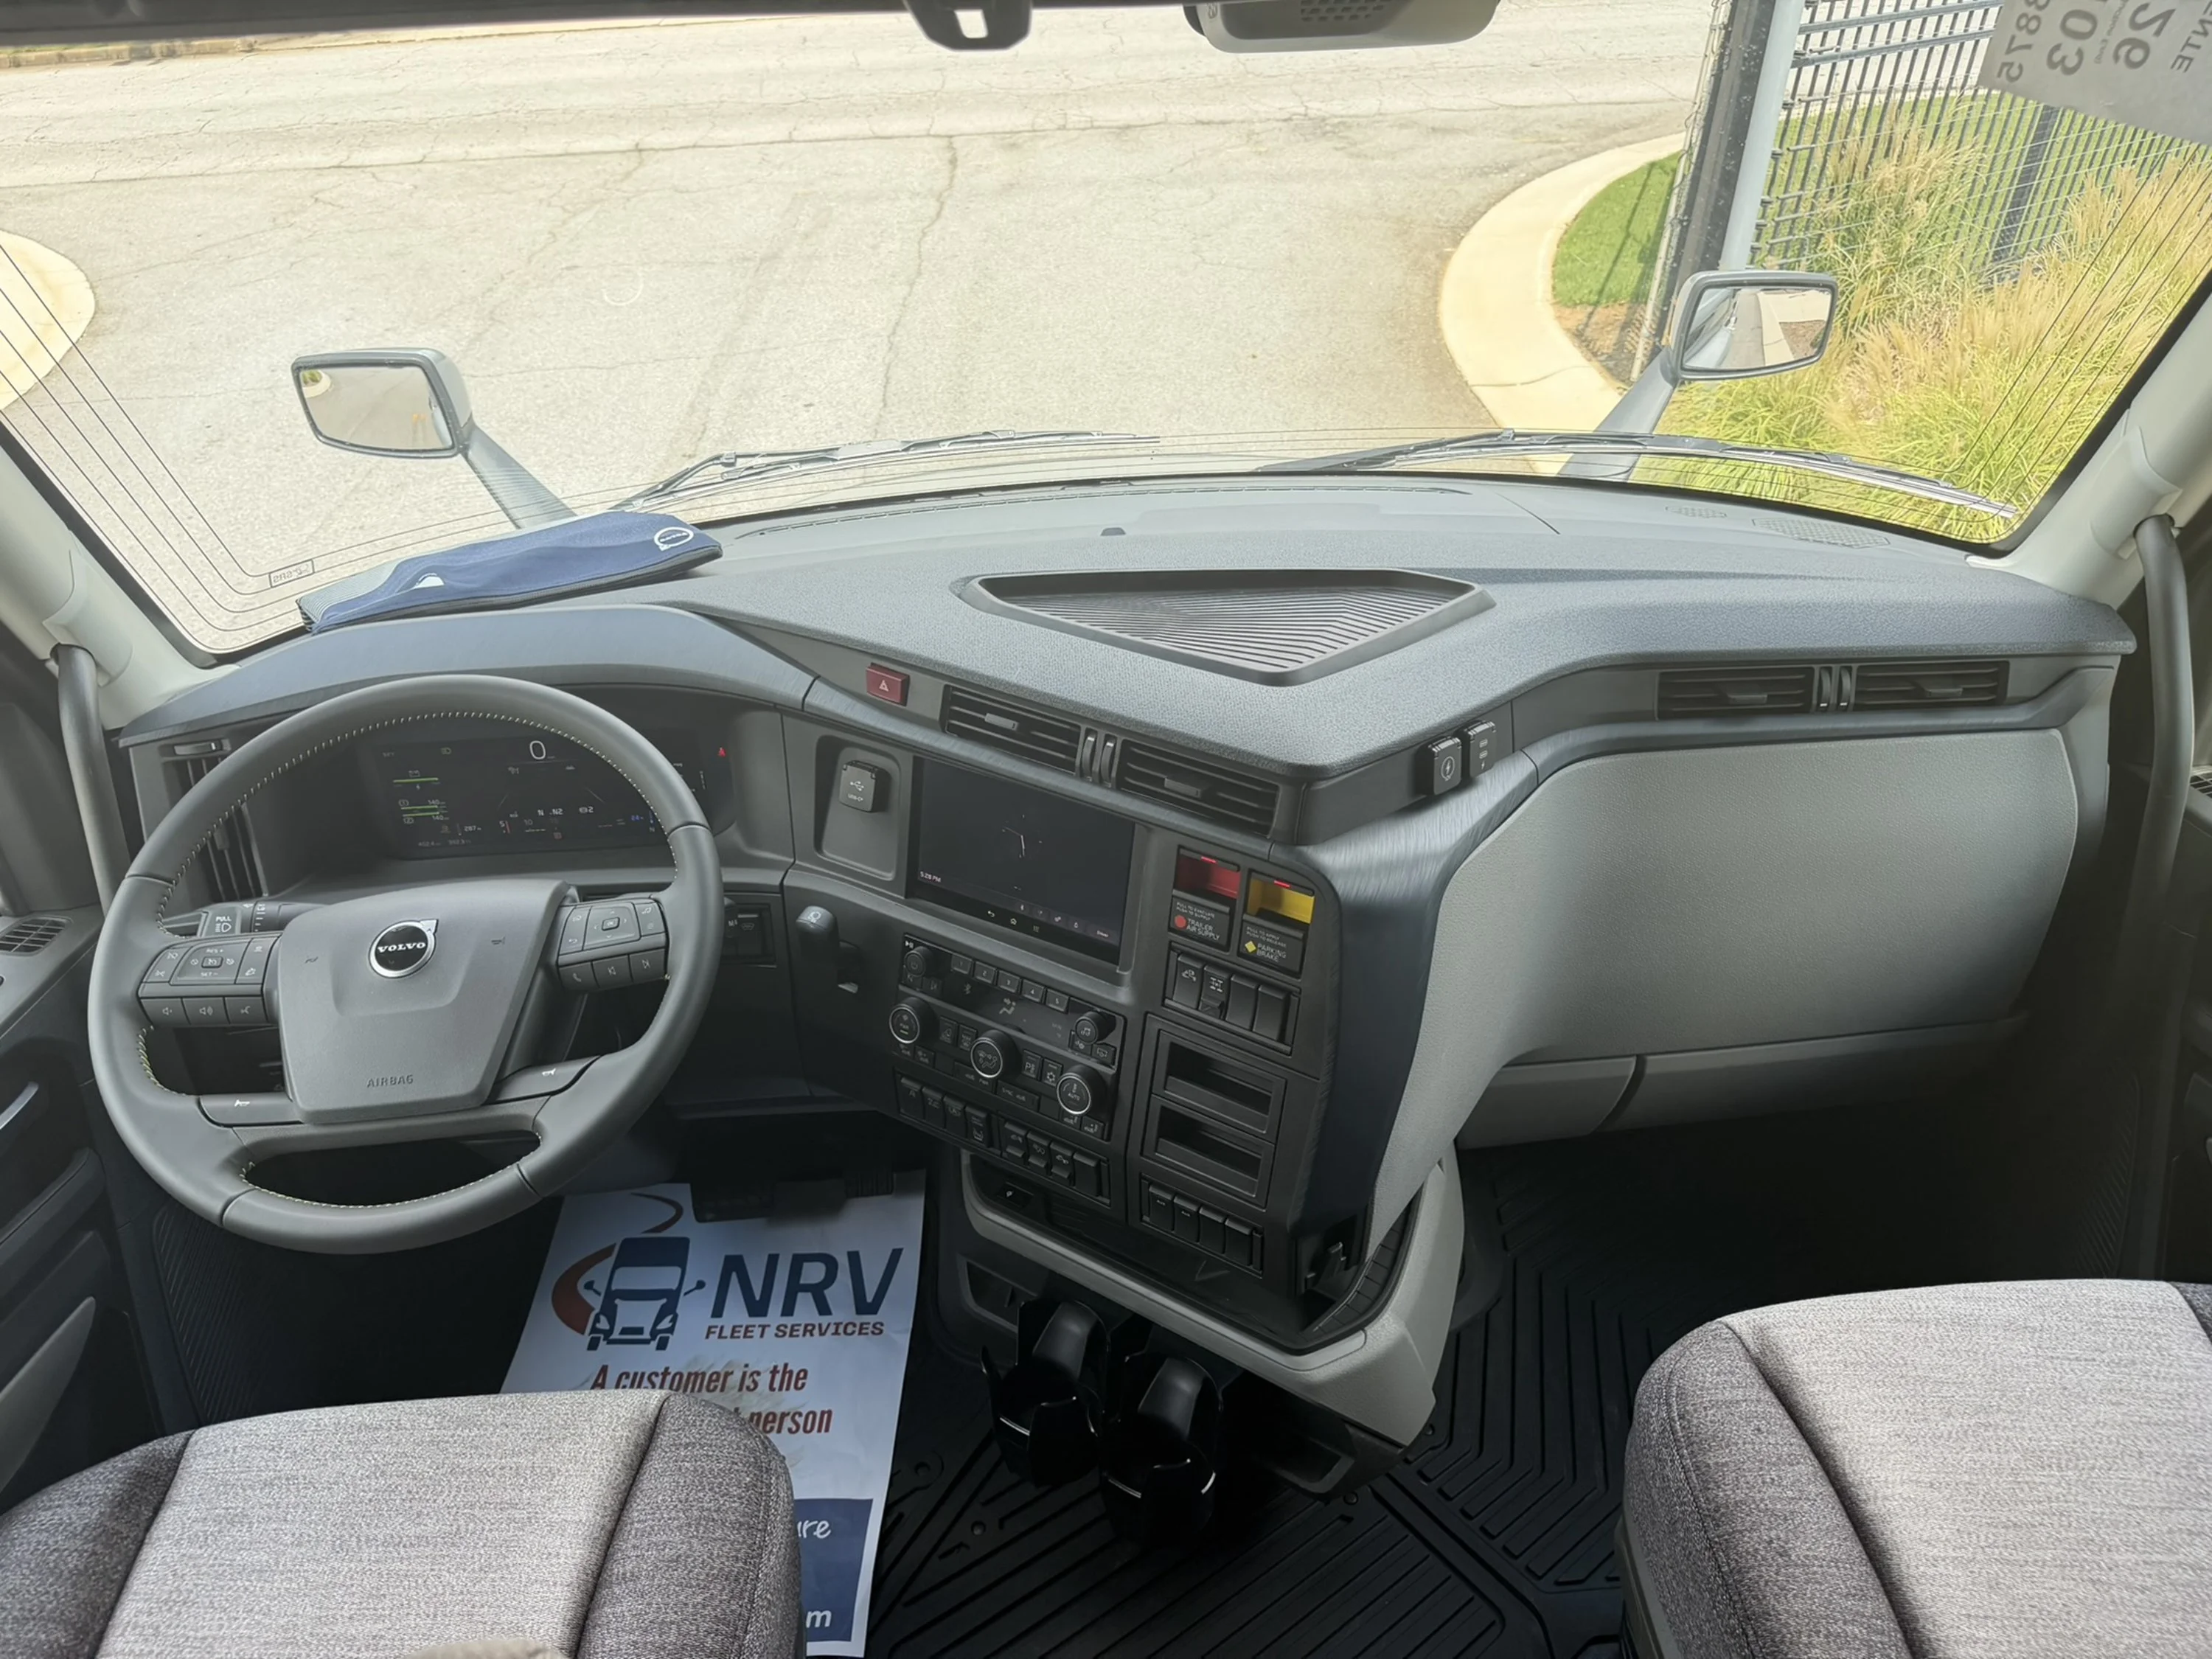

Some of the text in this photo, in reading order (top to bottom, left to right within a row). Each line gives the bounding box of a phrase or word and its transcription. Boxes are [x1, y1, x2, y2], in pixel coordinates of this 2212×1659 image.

[529, 740, 546, 760] 0
[377, 942, 426, 953] VOLVO
[366, 1074, 414, 1088] AIRBAG
[709, 1248, 905, 1318] NRV
[705, 1321, 885, 1340] FLEET SERVICES
[591, 1362, 809, 1394] A customer is the
